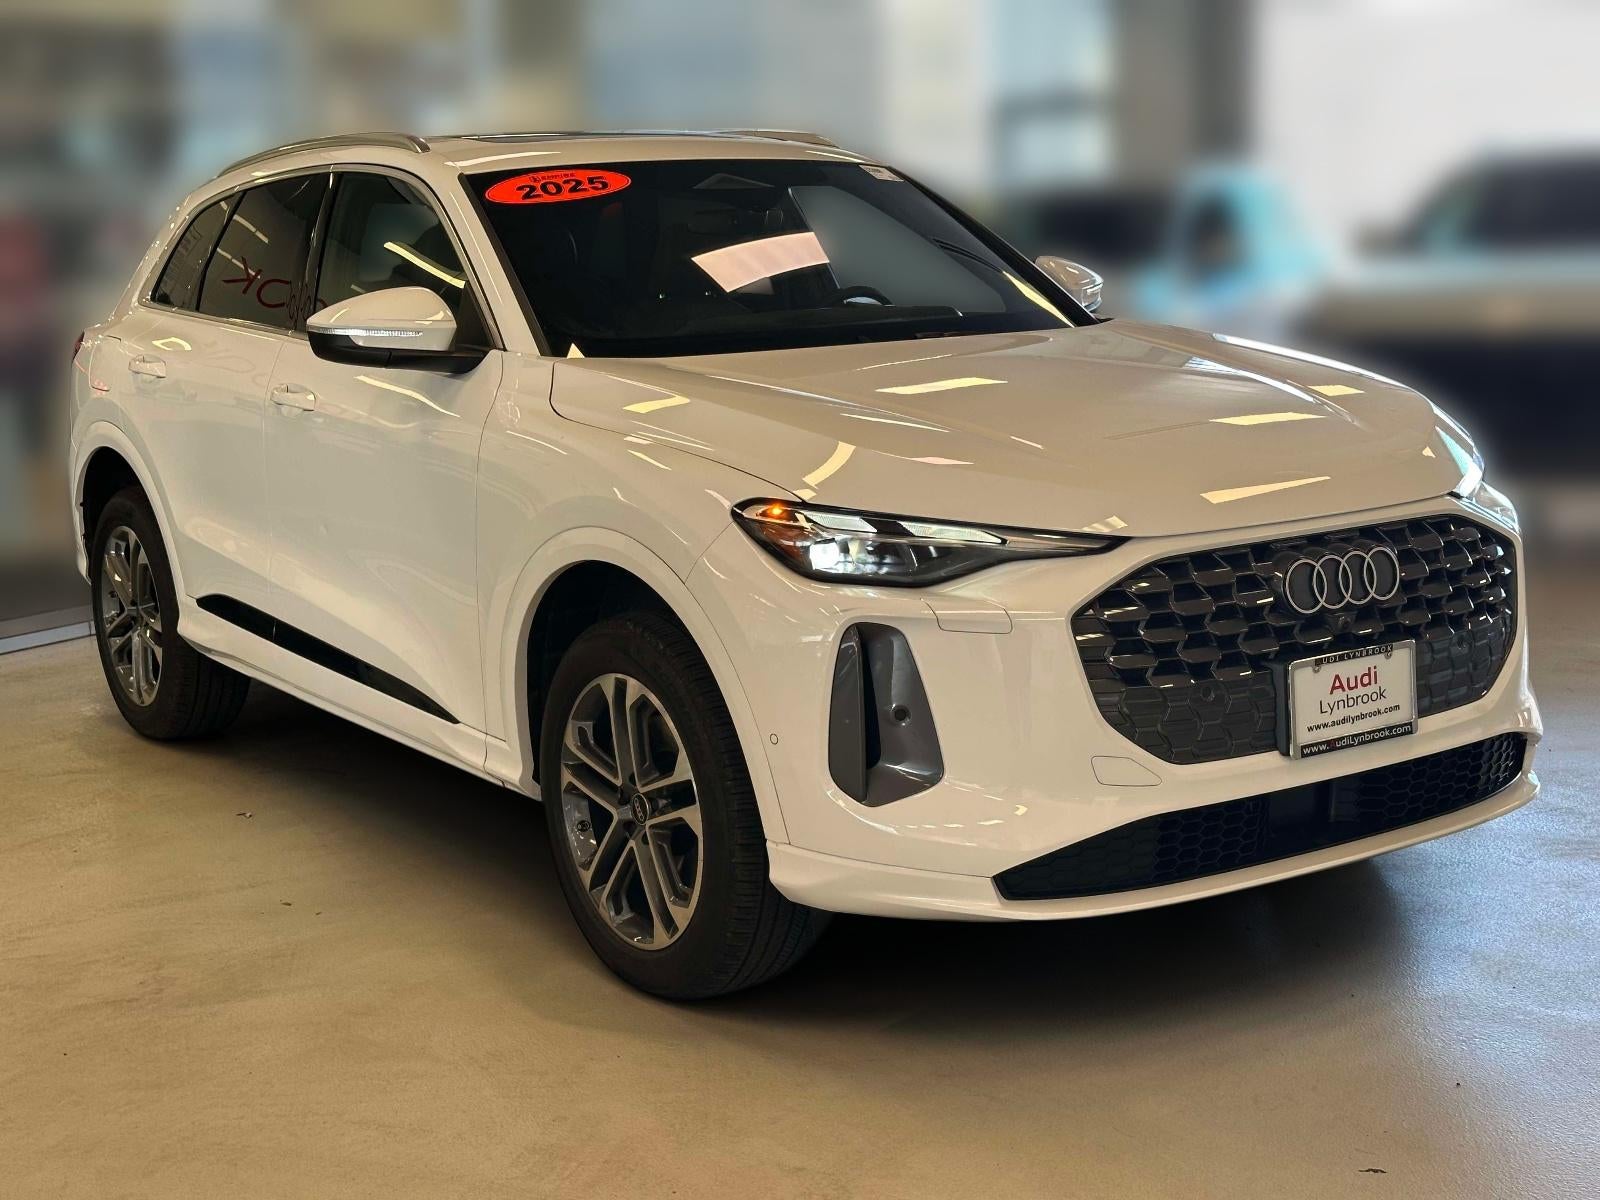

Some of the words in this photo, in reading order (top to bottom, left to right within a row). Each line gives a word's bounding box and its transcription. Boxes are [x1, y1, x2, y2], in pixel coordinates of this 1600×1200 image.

[516, 176, 609, 200] 2025
[1344, 645, 1392, 660] LYNBROOK
[1330, 666, 1378, 694] Audi
[1319, 686, 1387, 715] Lynbrook
[1307, 704, 1400, 732] www.audilynbrook.com
